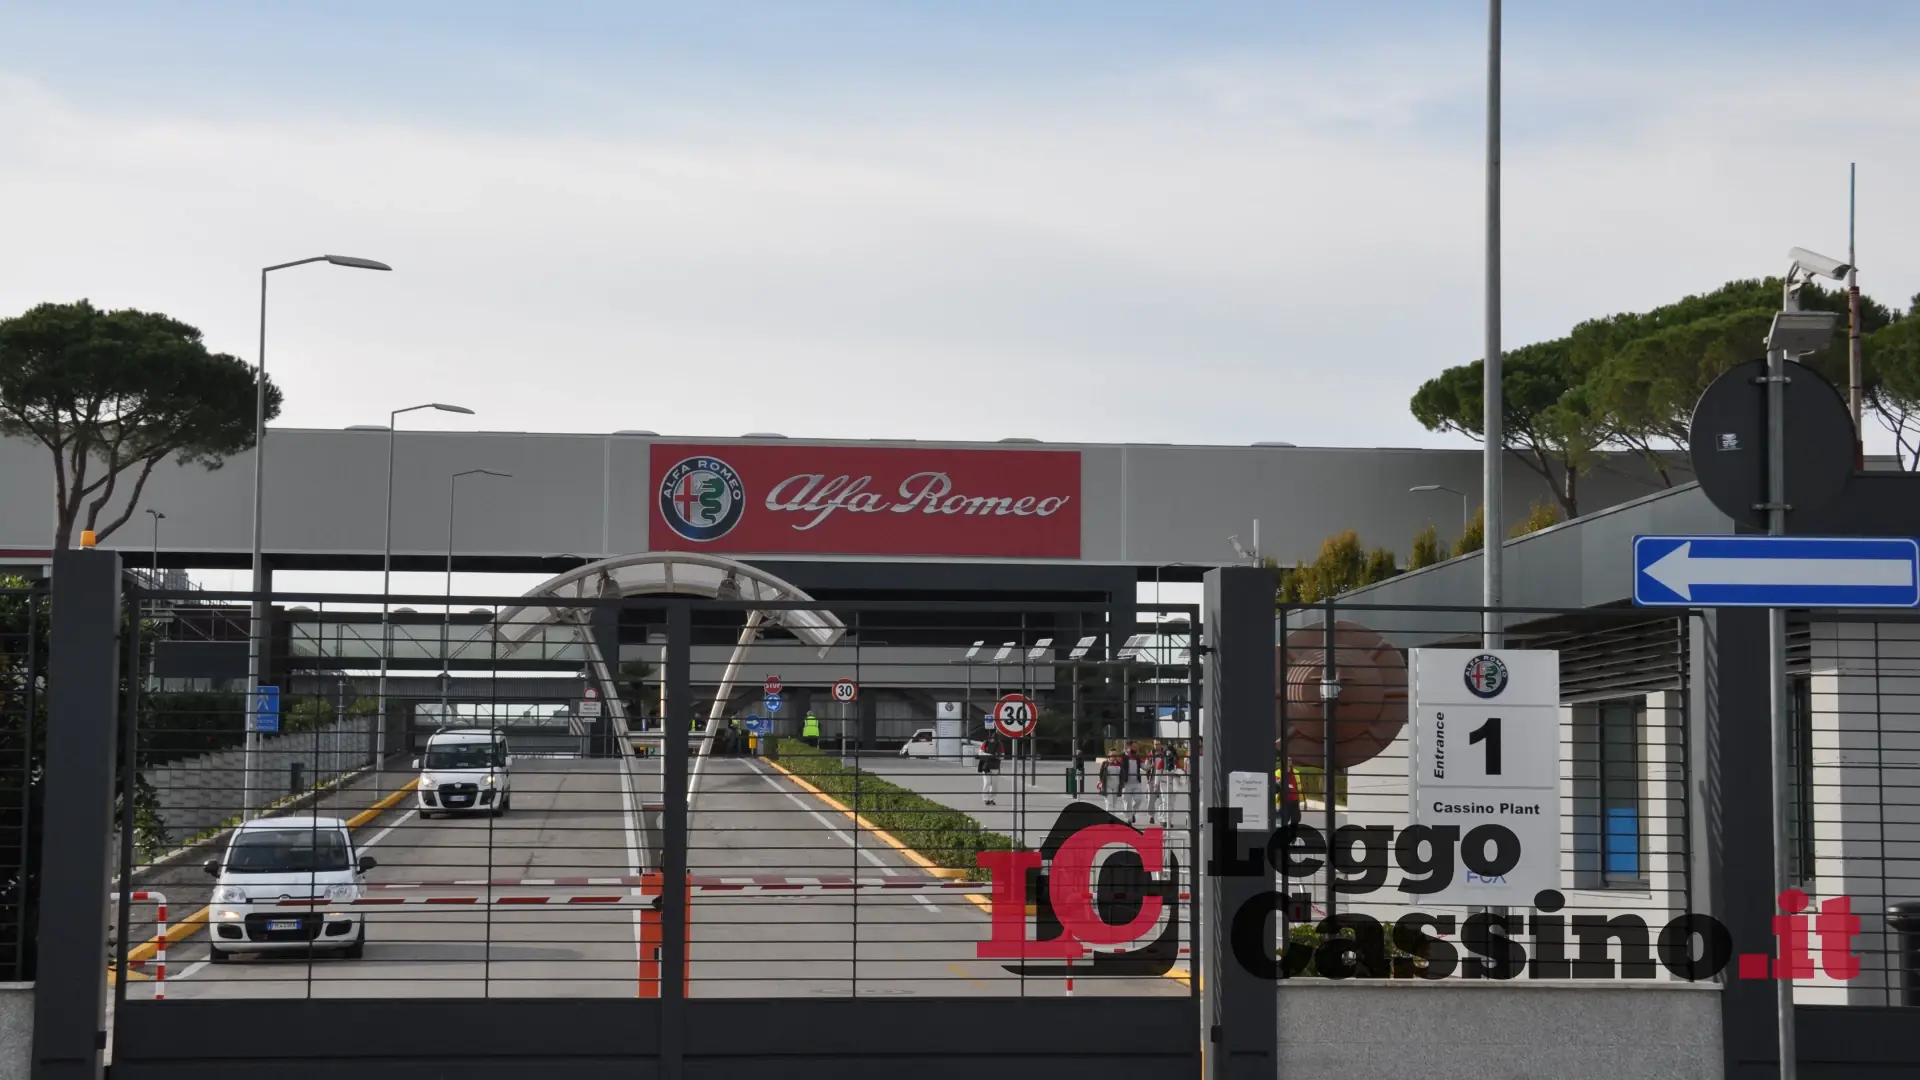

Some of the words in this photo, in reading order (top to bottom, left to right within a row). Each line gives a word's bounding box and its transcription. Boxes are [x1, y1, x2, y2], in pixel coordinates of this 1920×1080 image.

[663, 464, 691, 498] ALFA
[697, 459, 742, 500] ROMEO
[765, 473, 891, 531] Alfa
[889, 472, 1070, 516] Romeo
[1465, 657, 1480, 677] ALFA
[1483, 655, 1507, 678] ROMEO
[838, 685, 852, 697] 30
[1004, 706, 1028, 726] 30
[1433, 711, 1445, 779] Entrance
[1469, 717, 1502, 775] 1
[1433, 801, 1495, 814] Cassino
[1499, 802, 1540, 815] Plant
